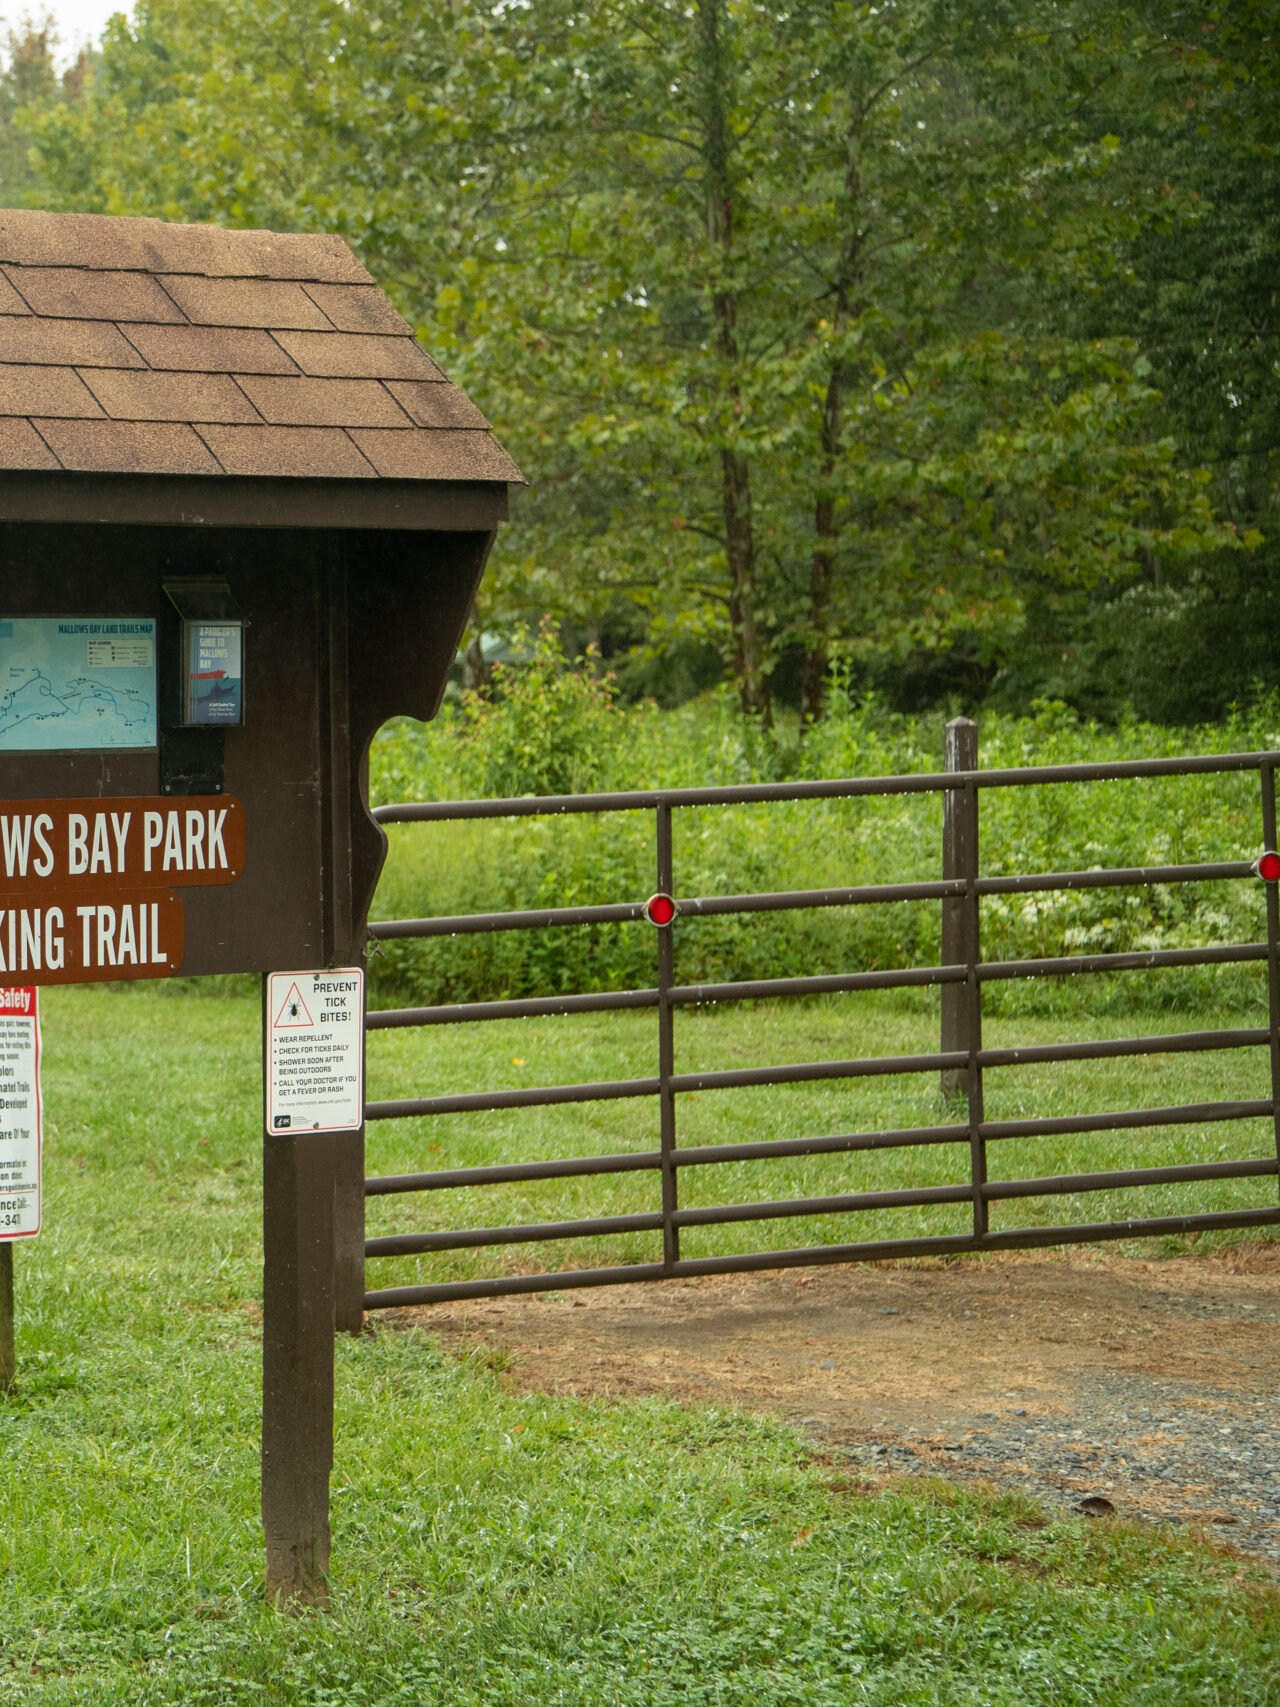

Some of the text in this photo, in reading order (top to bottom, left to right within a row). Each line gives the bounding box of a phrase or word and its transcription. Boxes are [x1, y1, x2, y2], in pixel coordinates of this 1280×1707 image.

[58, 624, 152, 634] MALLOWS BAY LAND TRAILS MAP
[200, 638, 224, 647] GUIDE TO
[200, 648, 228, 658] MALLOWS
[200, 660, 211, 669] BAY
[68, 812, 132, 875] BAY
[143, 809, 229, 872] PARK
[76, 903, 168, 967] TRAIL
[313, 982, 358, 992] PREVENT
[325, 997, 346, 1007] TICK
[320, 1012, 351, 1022] BITES!
[299, 1034, 333, 1042] REPELLENT
[279, 1058, 305, 1066] SHOWER
[299, 1066, 331, 1074] OUTDOORS
[313, 1077, 337, 1085] DOCTOR
[298, 1087, 317, 1095] FEVER
